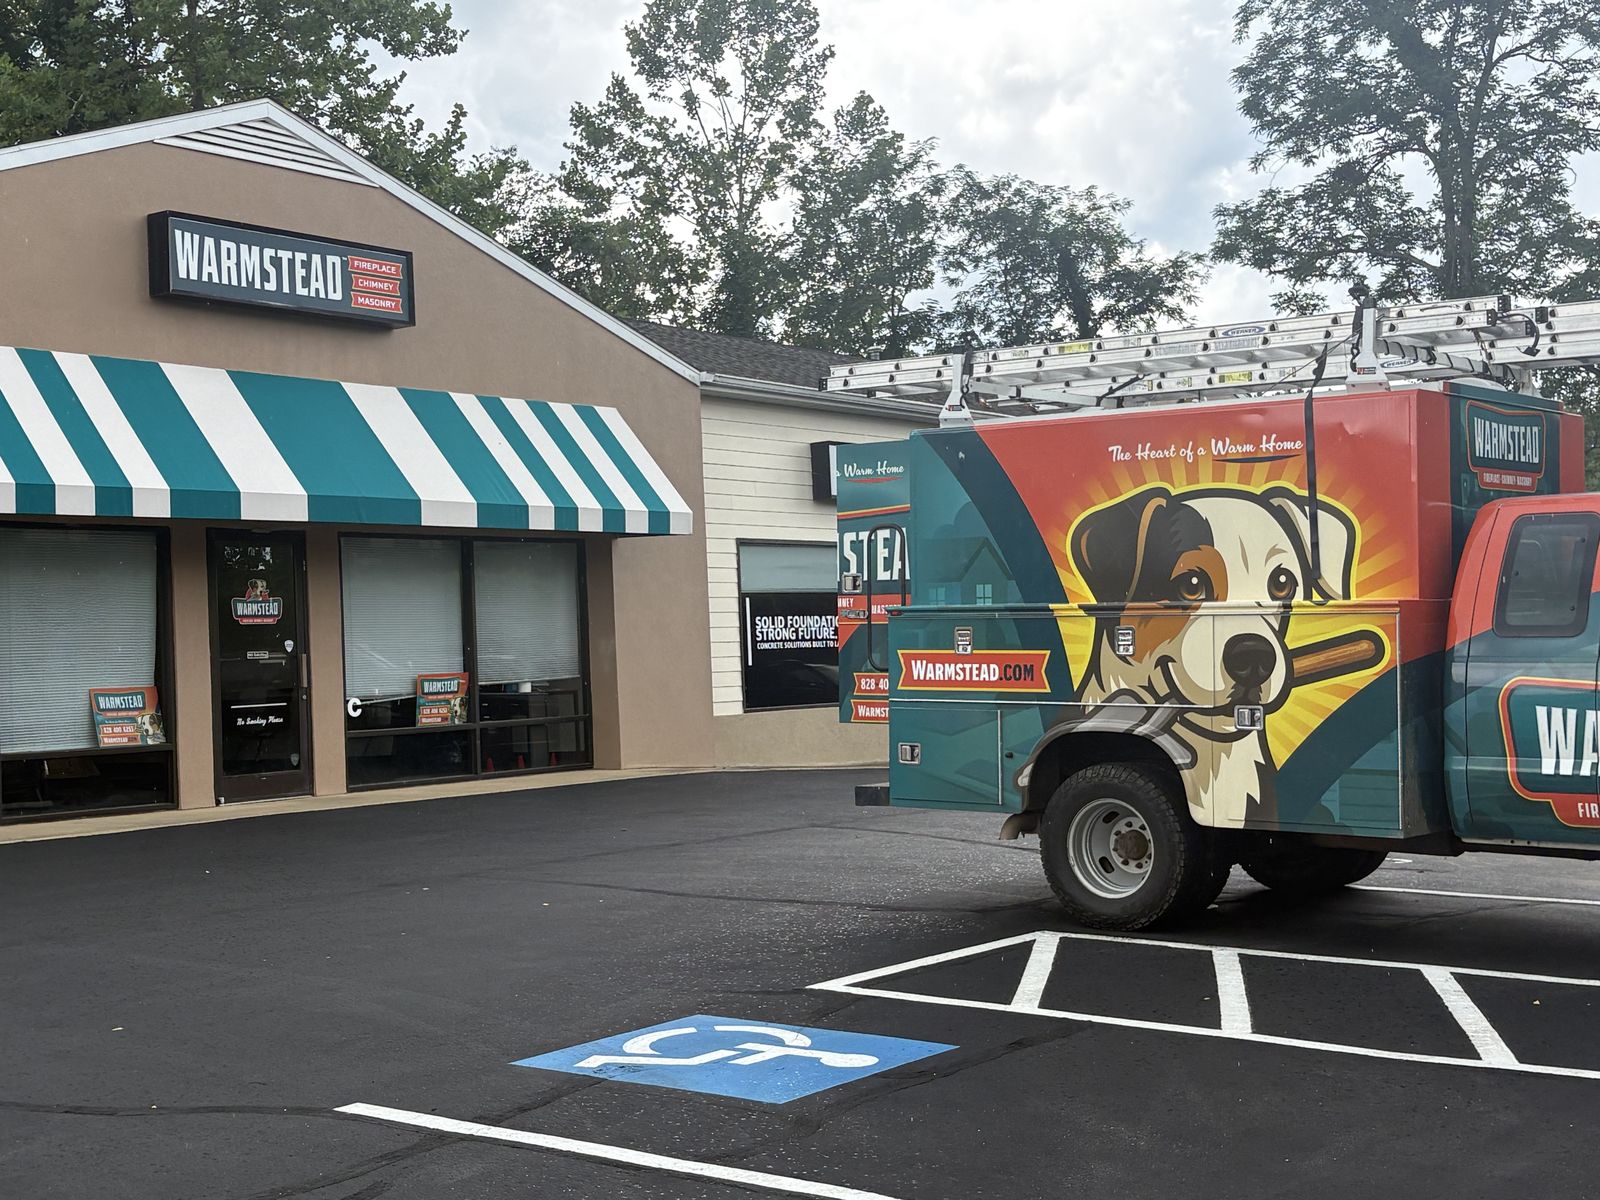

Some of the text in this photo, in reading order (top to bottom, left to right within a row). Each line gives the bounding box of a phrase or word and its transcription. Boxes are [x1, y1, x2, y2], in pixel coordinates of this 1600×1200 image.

[174, 229, 343, 301] WARMSTEAD
[354, 260, 397, 274] FIREPLACE
[358, 279, 394, 291] CHIMNEY
[357, 296, 396, 309] MASONRY
[1474, 416, 1539, 464] WARMSTEAD
[1108, 433, 1304, 463] The Heart of a Warm Home
[844, 463, 874, 477] Warm
[876, 460, 904, 475] Home
[838, 527, 911, 582] STEA
[236, 602, 279, 616] WARMSTEAD
[755, 616, 785, 629] SOLID
[756, 627, 796, 641] STRONG
[757, 641, 784, 650] CONCRETE
[784, 641, 812, 649] SOLUTIONS
[812, 640, 826, 648] BUILT
[827, 640, 835, 648] TO
[911, 660, 1034, 681] WARMSTEAD.COM
[423, 680, 458, 693] WARMSTEAD
[860, 678, 876, 690] 828
[98, 694, 143, 710] WARMSTEAD
